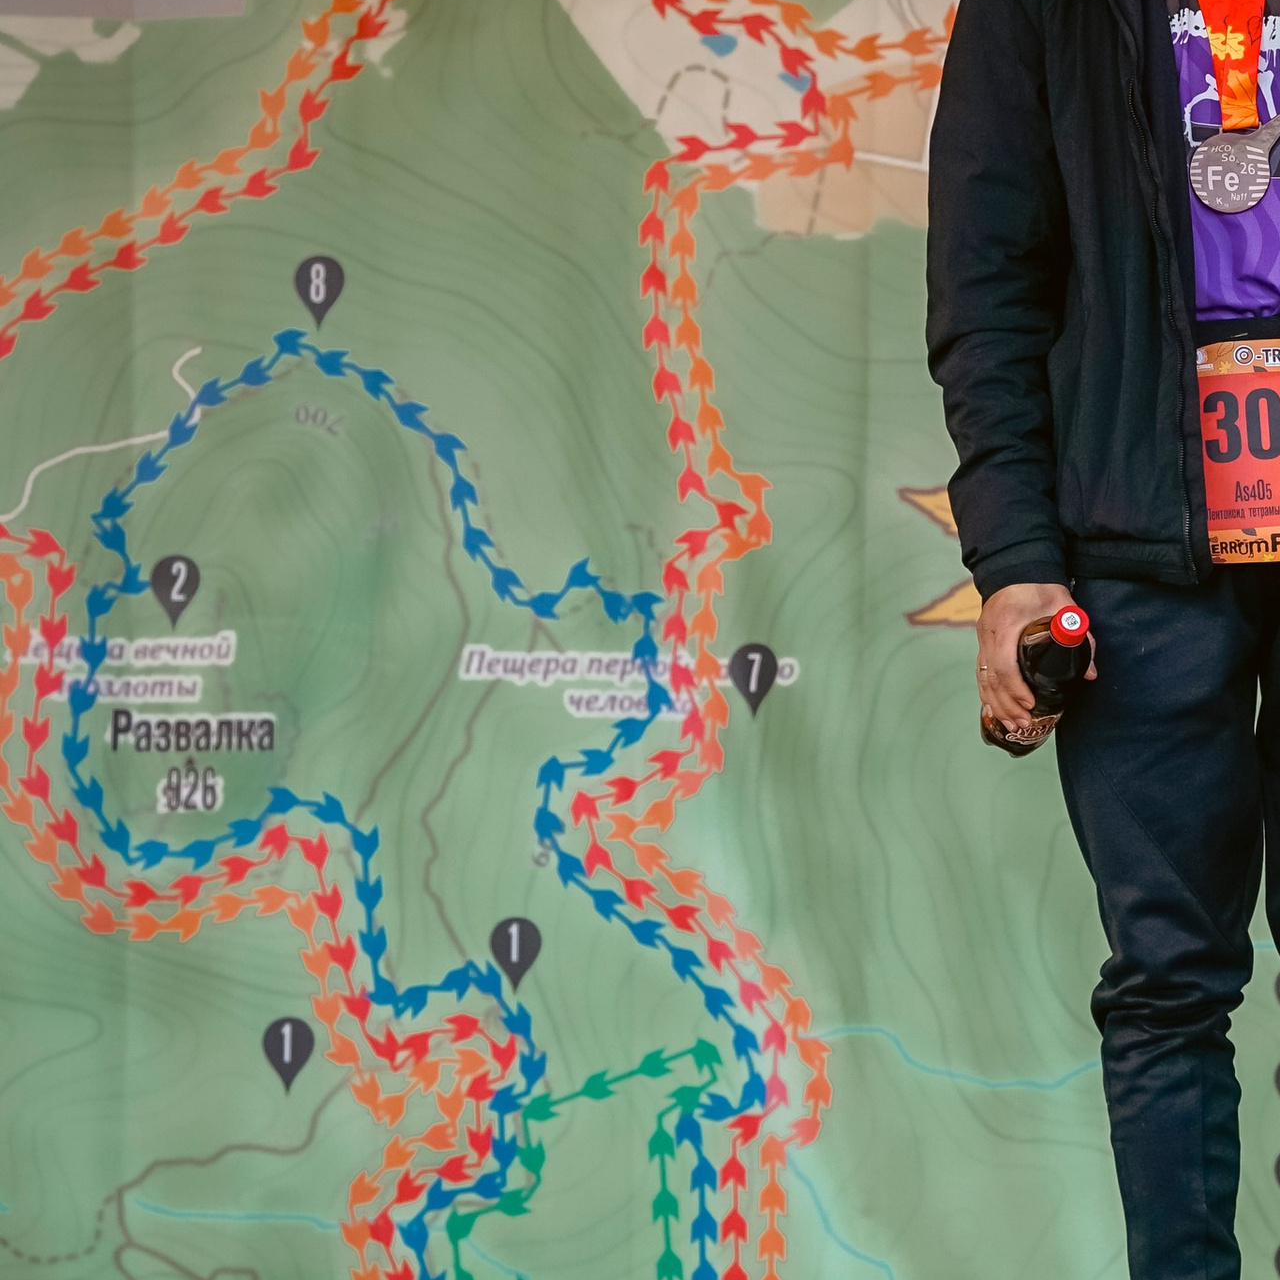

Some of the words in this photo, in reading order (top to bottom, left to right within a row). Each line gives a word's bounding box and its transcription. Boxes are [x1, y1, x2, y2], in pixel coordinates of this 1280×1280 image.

[1207, 165, 1240, 192] Fe
[1240, 162, 1256, 175] 26
[310, 263, 327, 305] 8
[171, 562, 187, 601] 2
[747, 653, 763, 693] 7
[111, 708, 275, 754] Развалка
[507, 924, 520, 964] 1
[281, 1024, 292, 1062] 1
